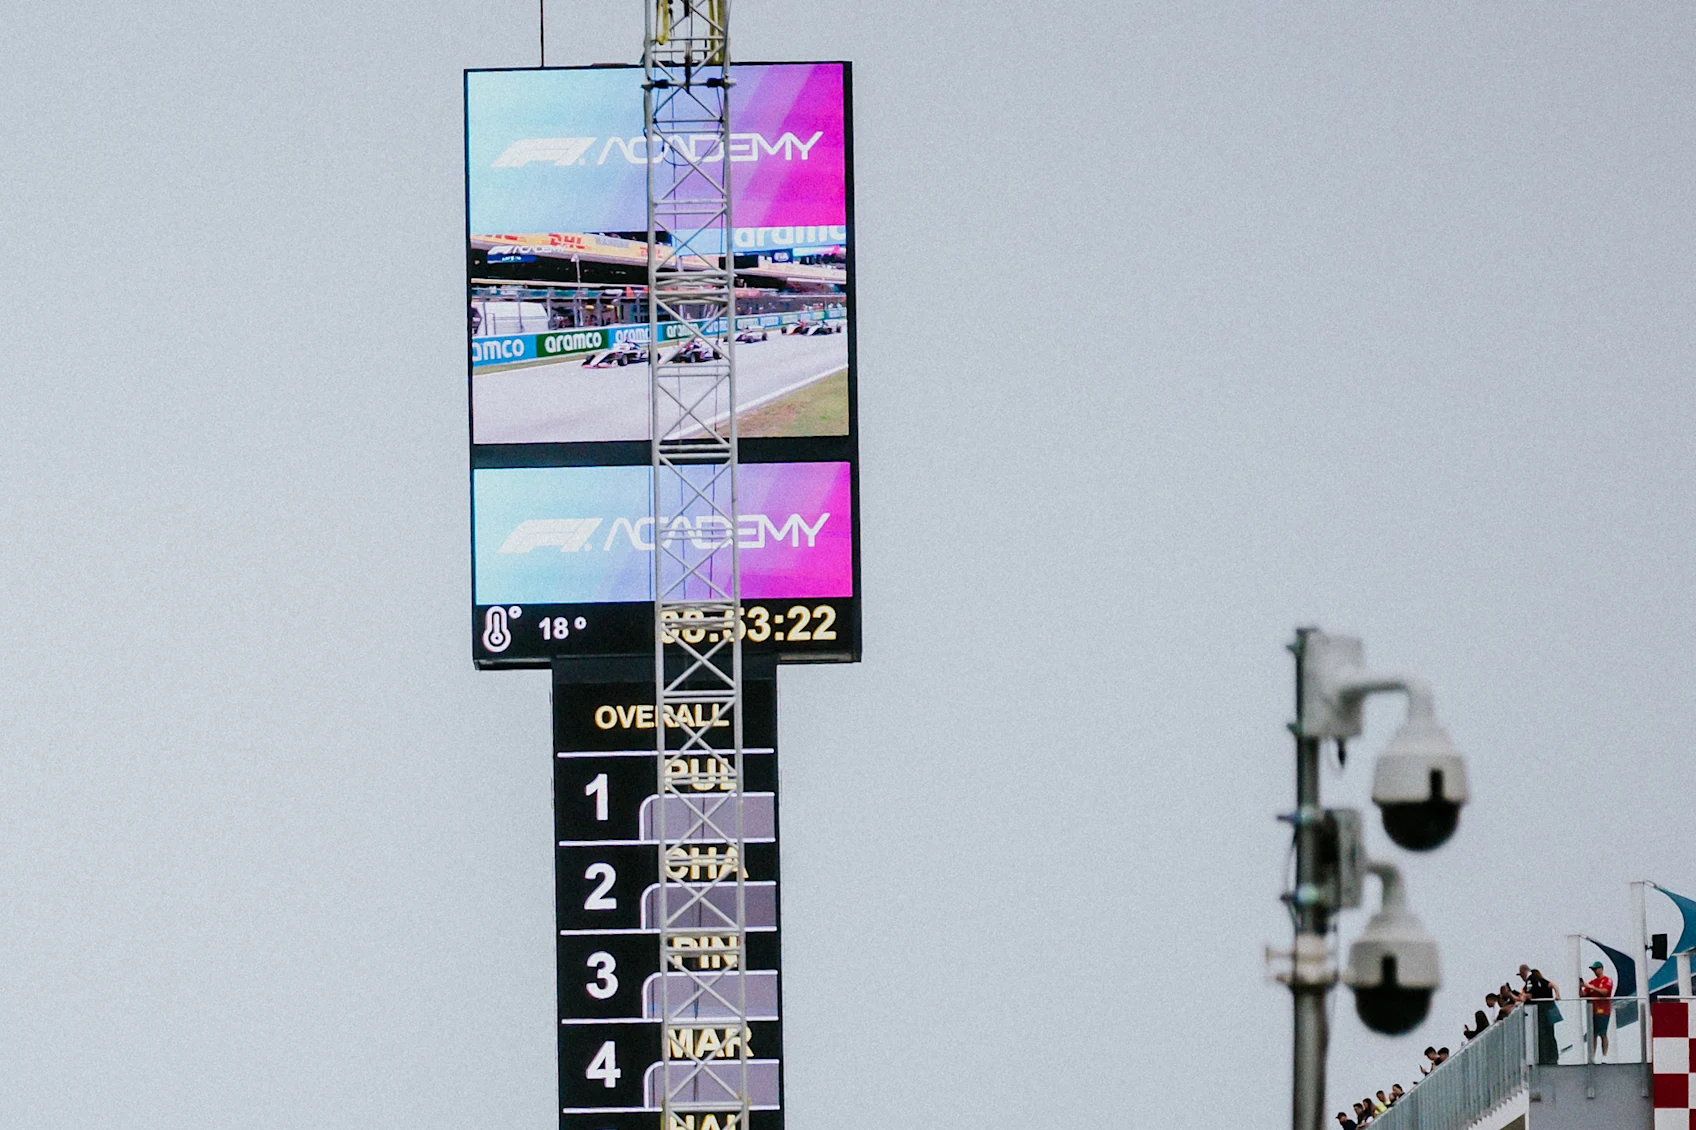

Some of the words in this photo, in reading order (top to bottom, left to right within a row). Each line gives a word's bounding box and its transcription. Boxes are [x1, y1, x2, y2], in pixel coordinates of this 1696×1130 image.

[597, 131, 824, 165] ACADEMY
[544, 331, 602, 353] aramco
[603, 512, 831, 551] ACADEMY
[594, 703, 730, 729] OVERALL
[585, 773, 609, 821] 1
[584, 863, 617, 910] 2
[586, 950, 619, 999] 3
[586, 1040, 621, 1088] 4
[667, 1027, 754, 1058] MAR
